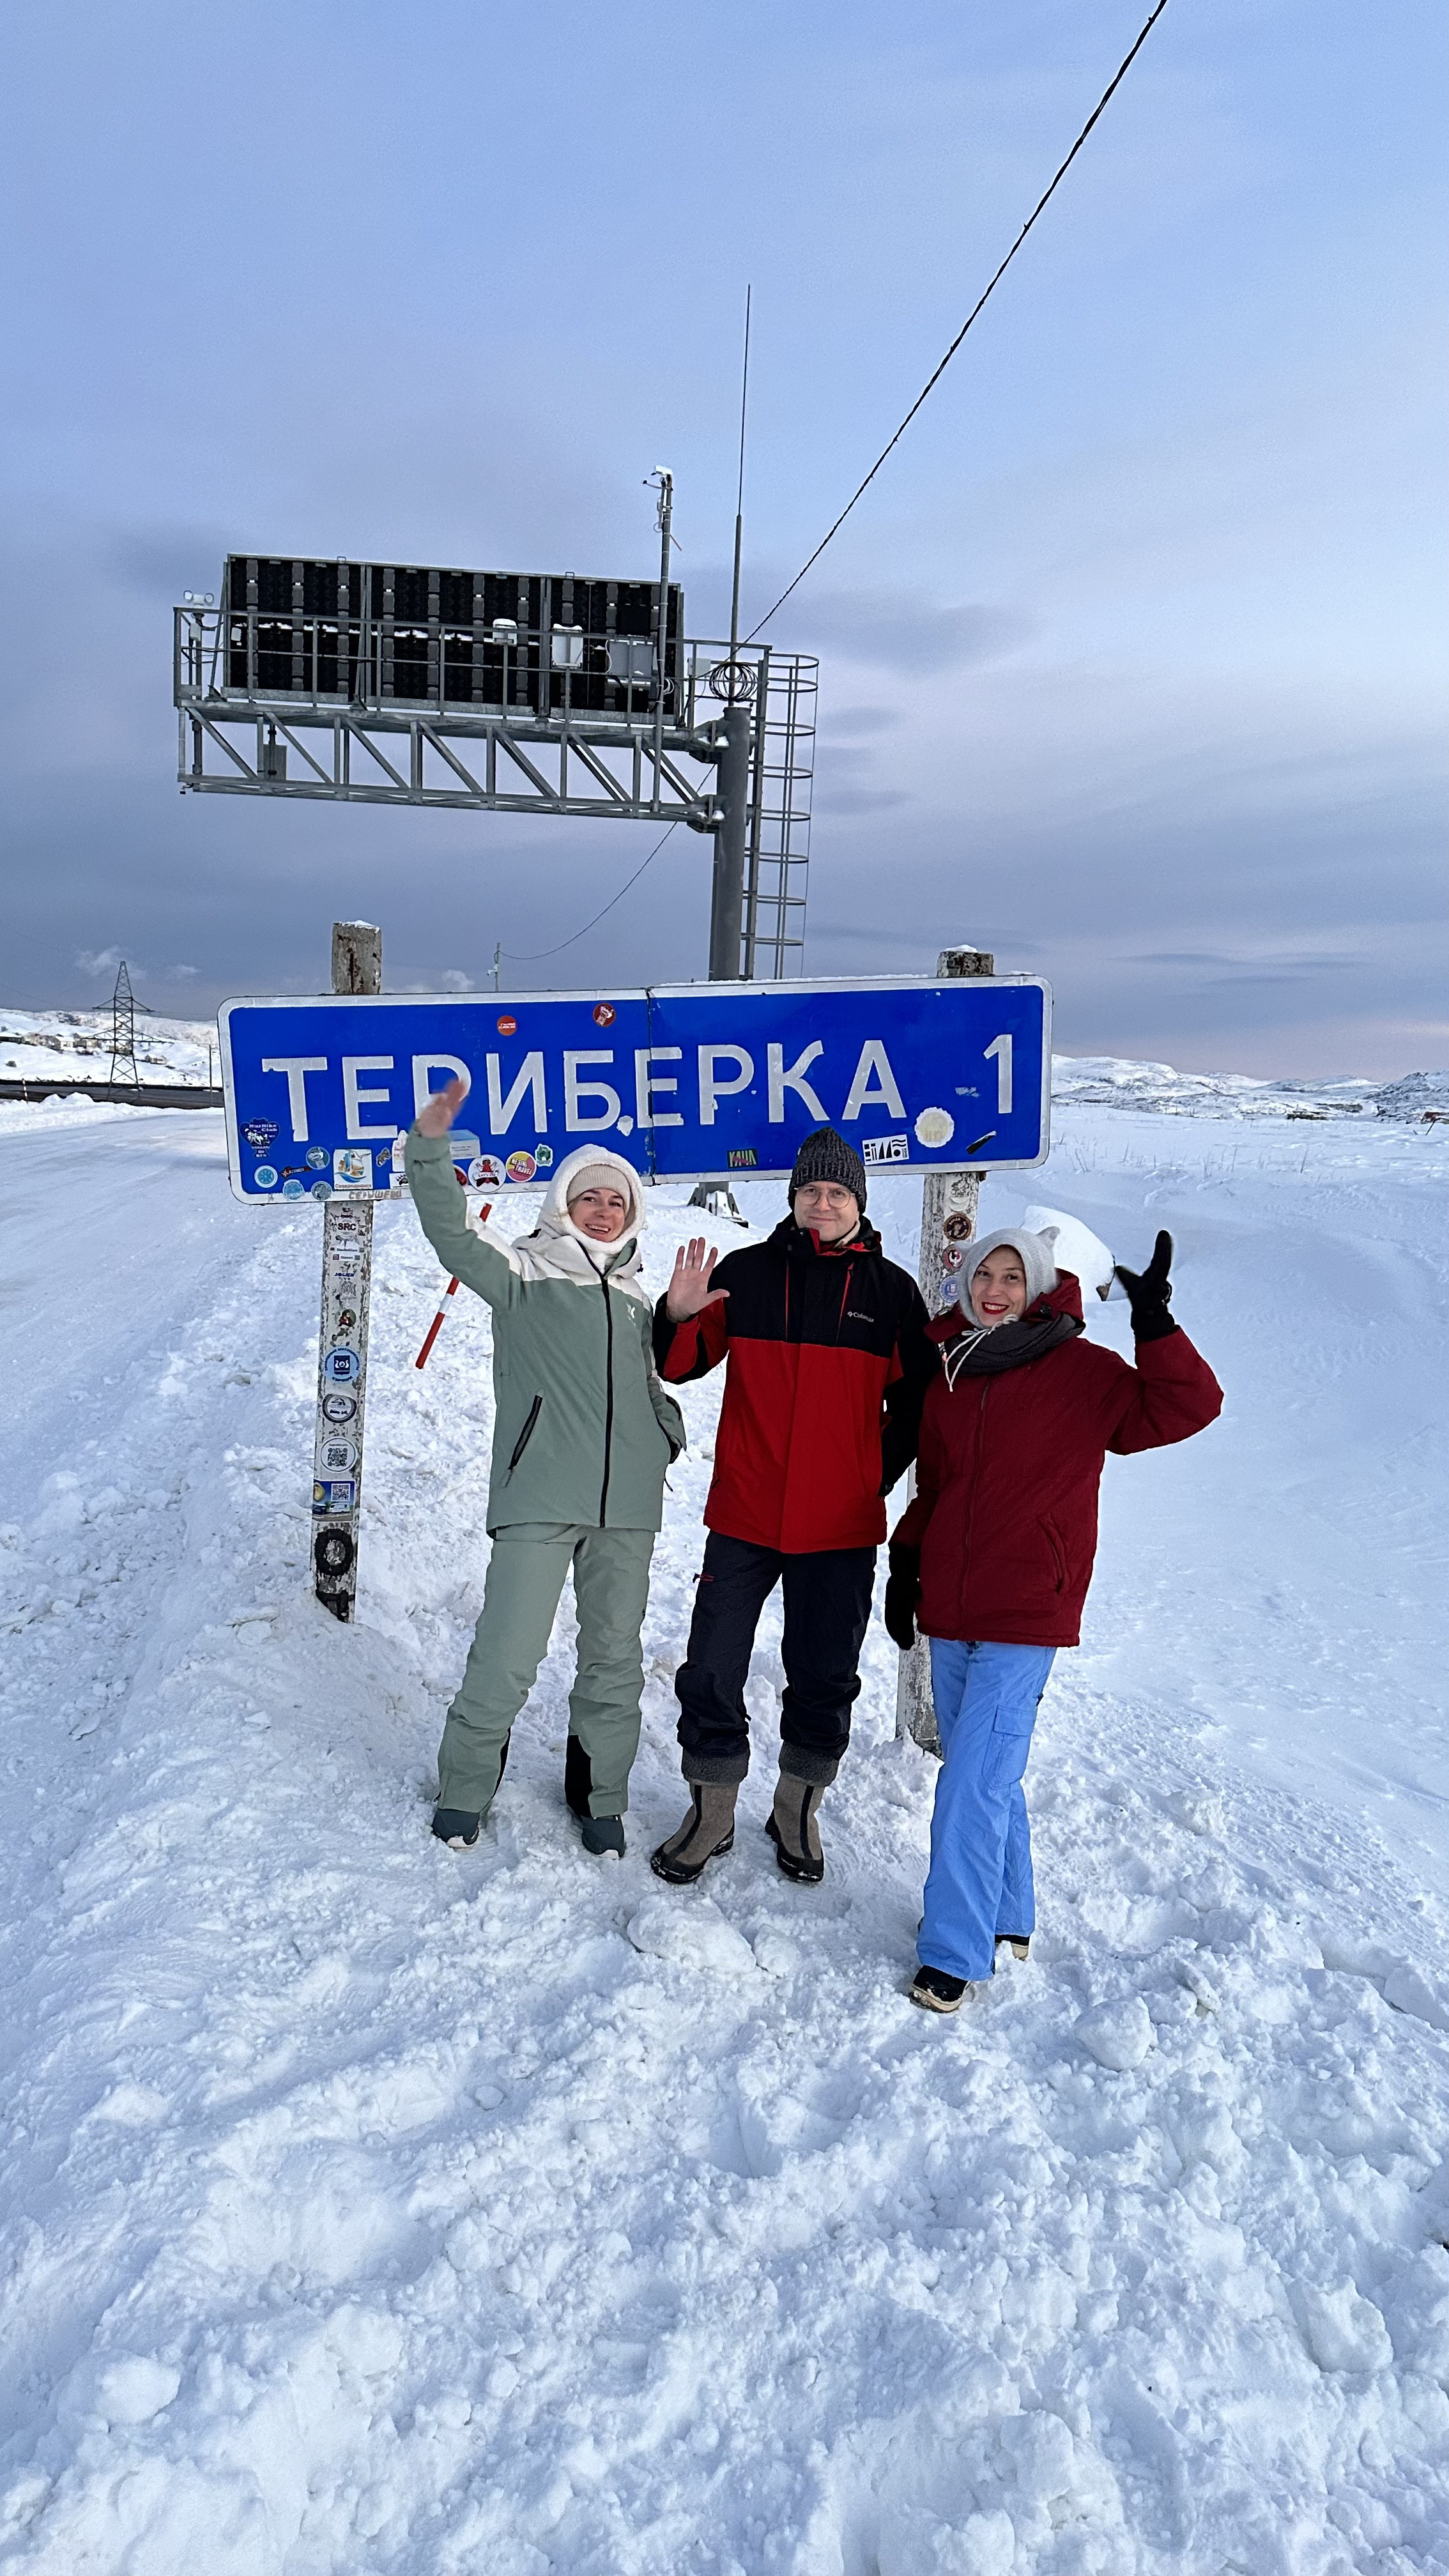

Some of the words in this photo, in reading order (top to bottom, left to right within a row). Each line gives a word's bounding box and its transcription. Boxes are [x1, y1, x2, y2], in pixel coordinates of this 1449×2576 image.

[261, 1039, 907, 1142] ТЕРИБЕРКА
[983, 1033, 1013, 1115] 1
[337, 1222, 356, 1231] SRC
